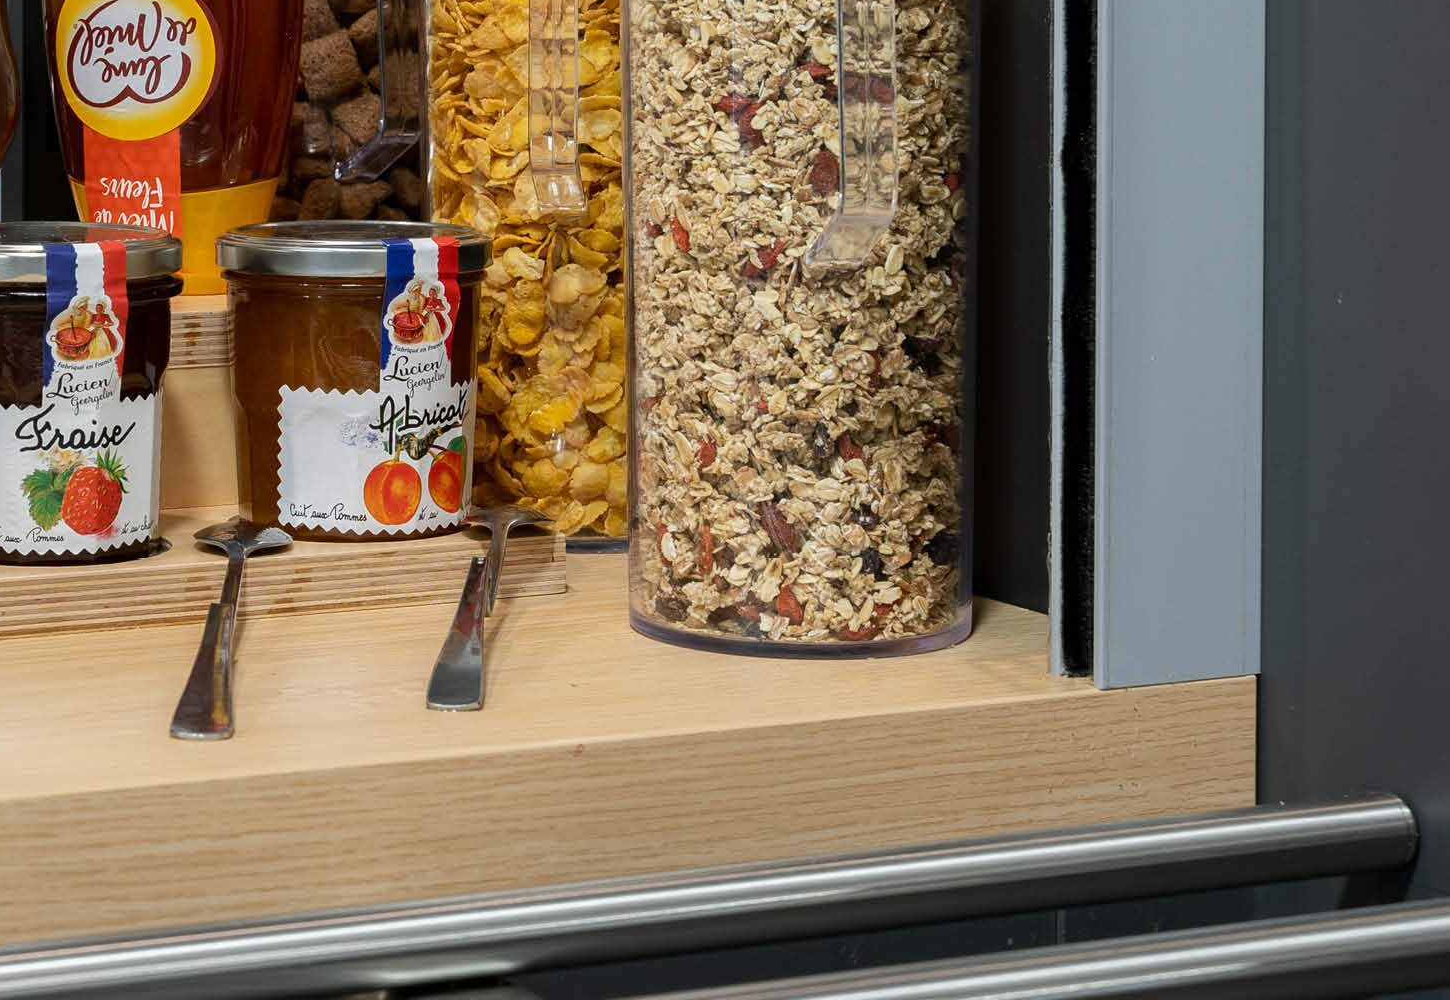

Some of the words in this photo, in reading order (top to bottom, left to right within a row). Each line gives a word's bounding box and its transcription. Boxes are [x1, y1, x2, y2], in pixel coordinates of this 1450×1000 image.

[164, 17, 197, 46] de
[99, 176, 164, 210] Fleurs
[382, 353, 444, 382] Lucien
[45, 369, 114, 399] Lucien
[15, 404, 137, 452] Fraise
[369, 389, 468, 455] Abricot
[289, 503, 312, 518] Cuit
[310, 510, 329, 519] aux
[330, 502, 368, 521] Pommes
[3, 534, 22, 543] aux
[25, 526, 65, 543] Pommes
